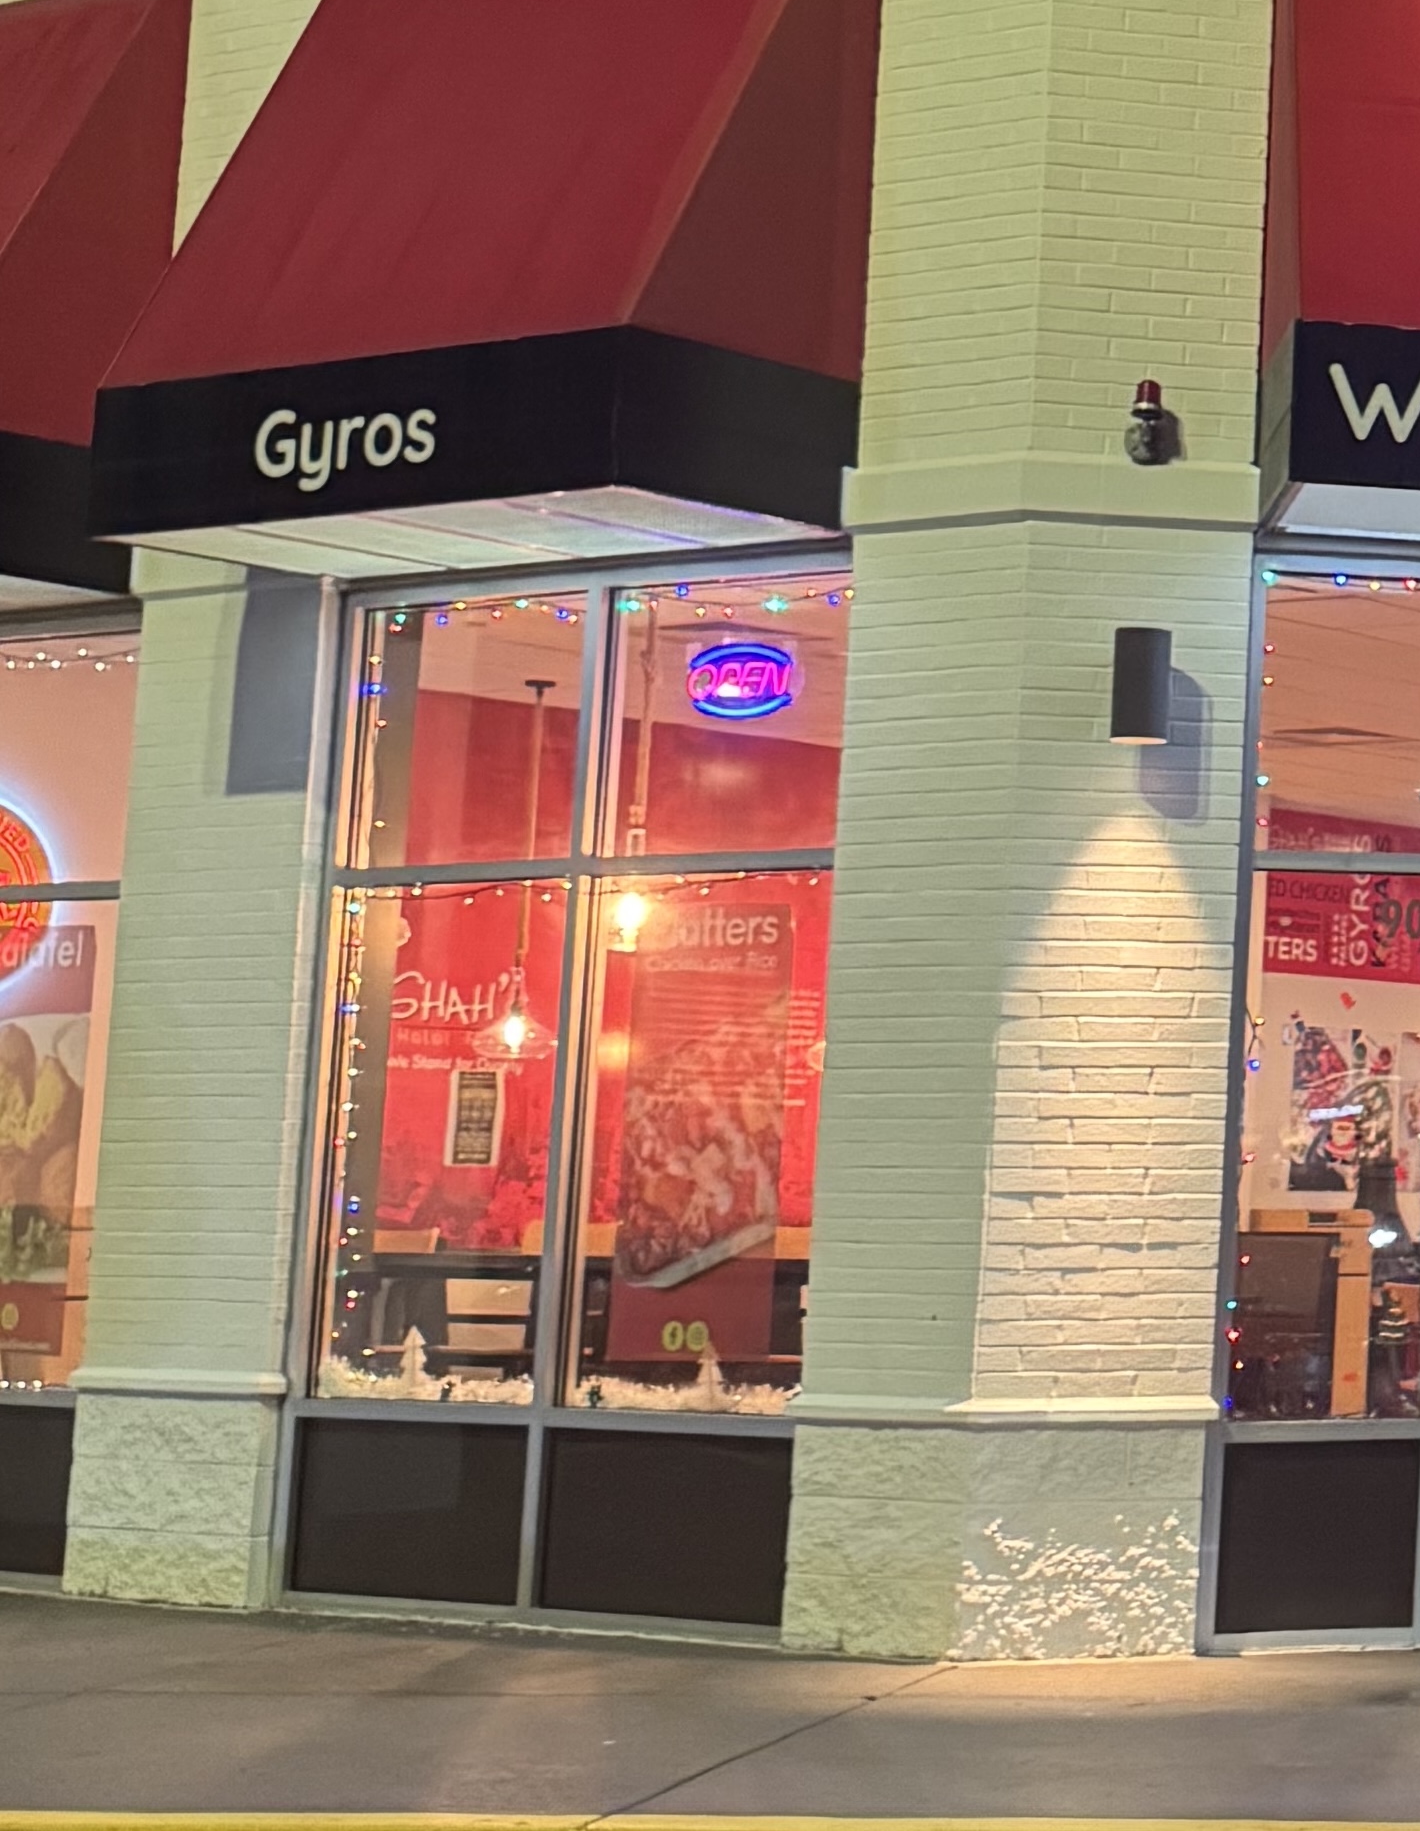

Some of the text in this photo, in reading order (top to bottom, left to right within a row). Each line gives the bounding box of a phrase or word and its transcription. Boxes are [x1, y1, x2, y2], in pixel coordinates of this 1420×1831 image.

[255, 408, 436, 492] Gyros
[686, 661, 791, 700] OPEN
[675, 906, 780, 946] atters
[0, 929, 83, 968] alafel
[1265, 936, 1318, 962] TERS
[392, 971, 510, 1024] SHAH'
